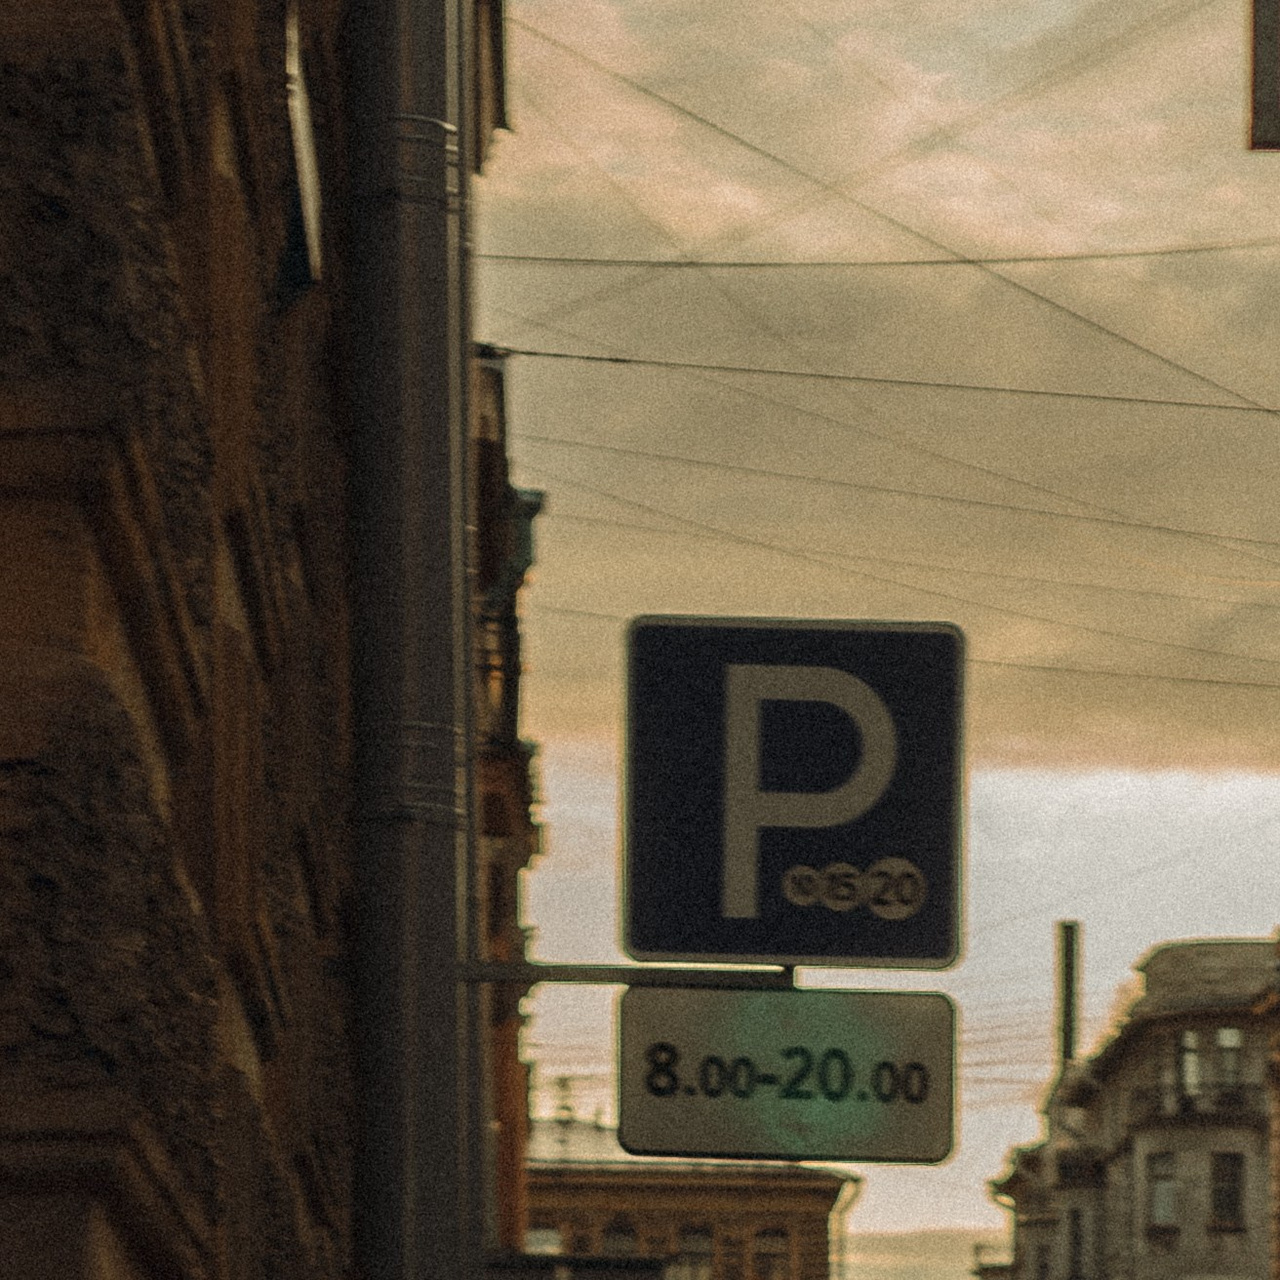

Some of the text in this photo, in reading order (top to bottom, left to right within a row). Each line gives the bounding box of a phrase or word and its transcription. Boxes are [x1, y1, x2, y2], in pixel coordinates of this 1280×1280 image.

[720, 663, 898, 919] P
[869, 870, 920, 906] 20
[645, 1042, 930, 1104] 8.00-20.00
